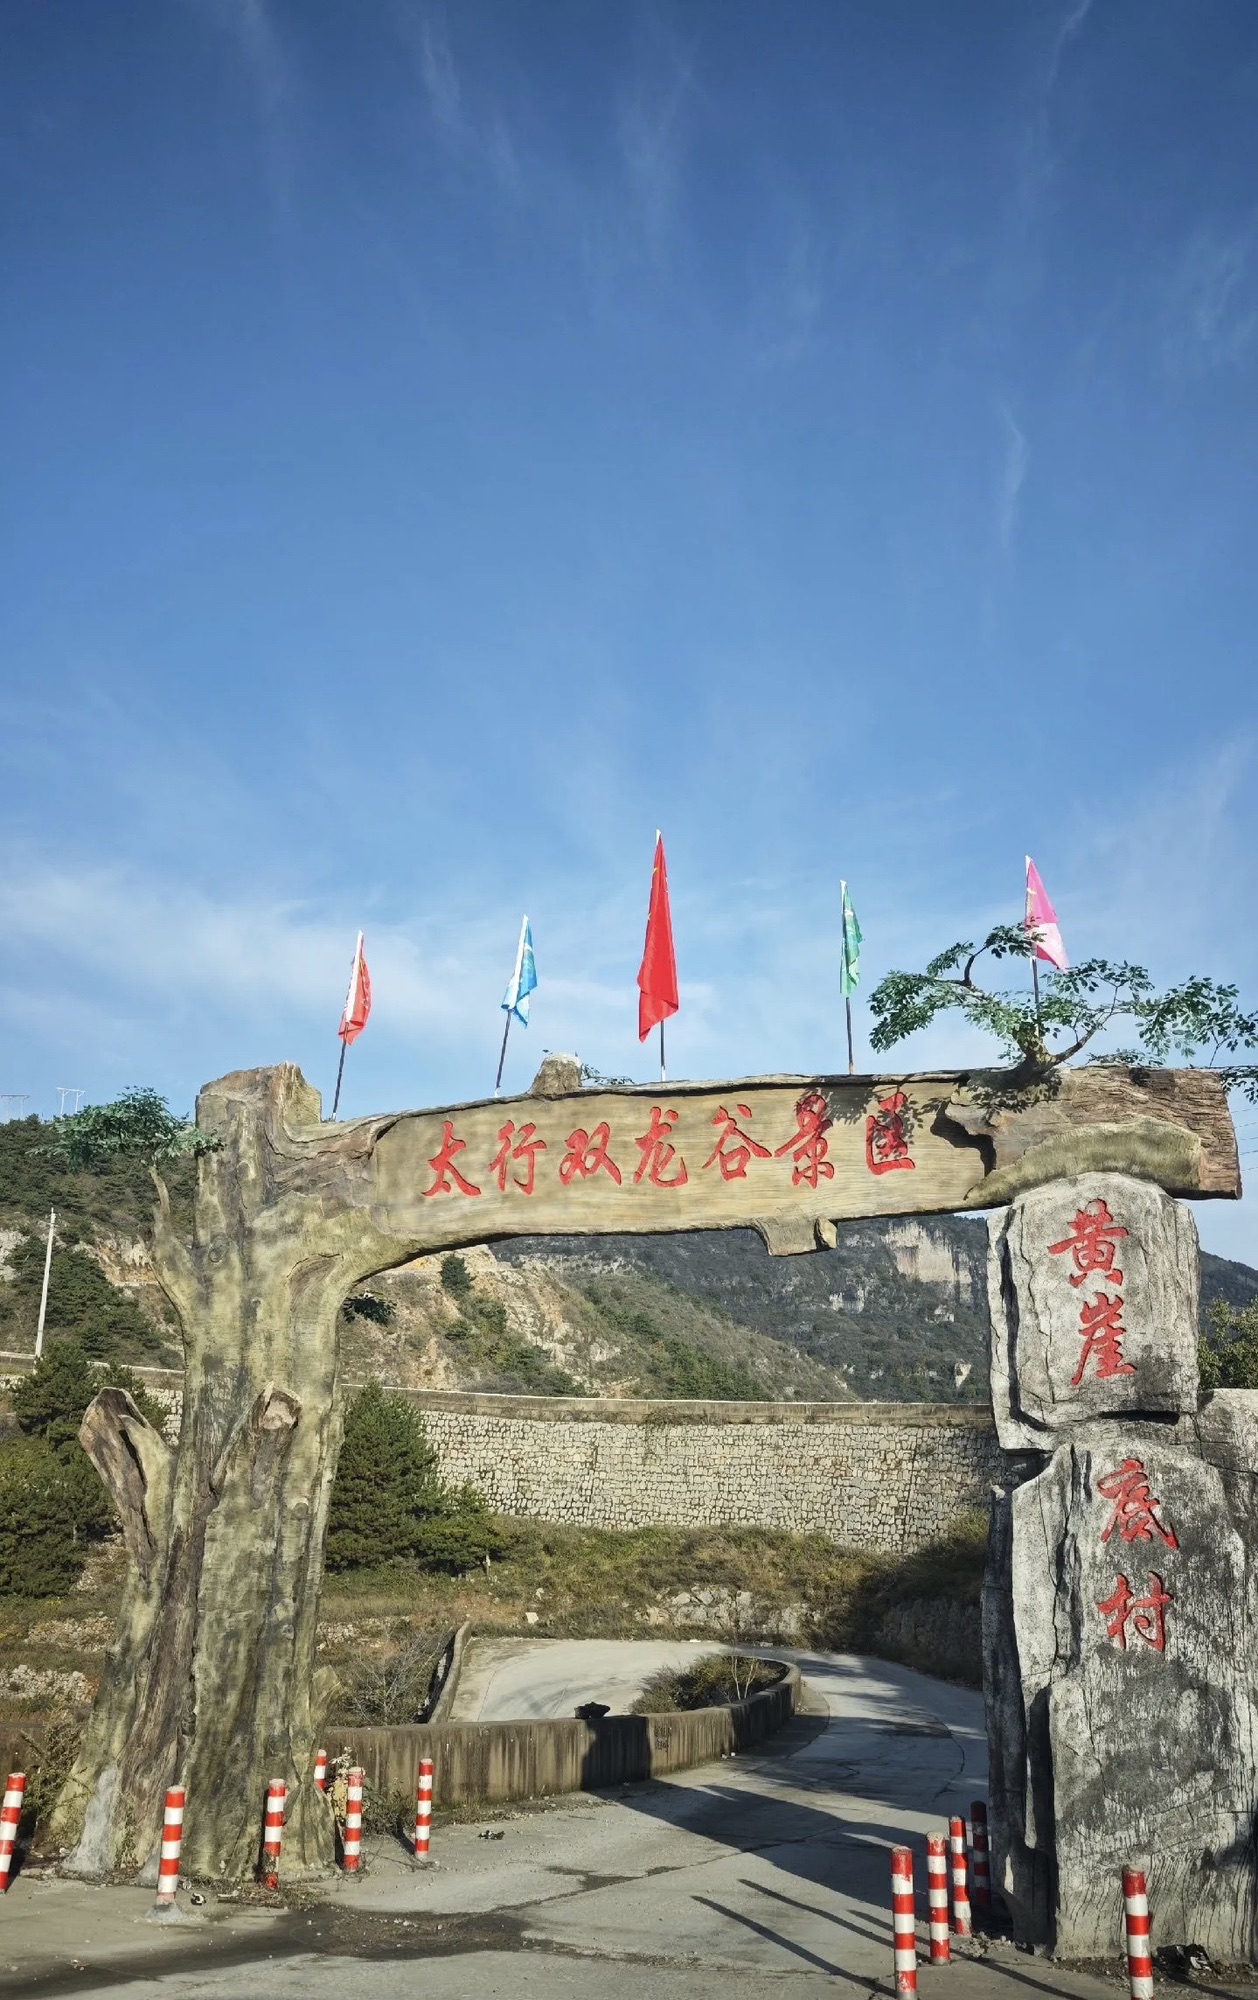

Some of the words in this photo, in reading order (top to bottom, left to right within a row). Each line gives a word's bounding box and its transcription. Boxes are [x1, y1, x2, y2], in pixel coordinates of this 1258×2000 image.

[421, 1092, 916, 1198] 太行双龙谷景区
[1047, 1198, 1180, 1652] 黄崖底村
